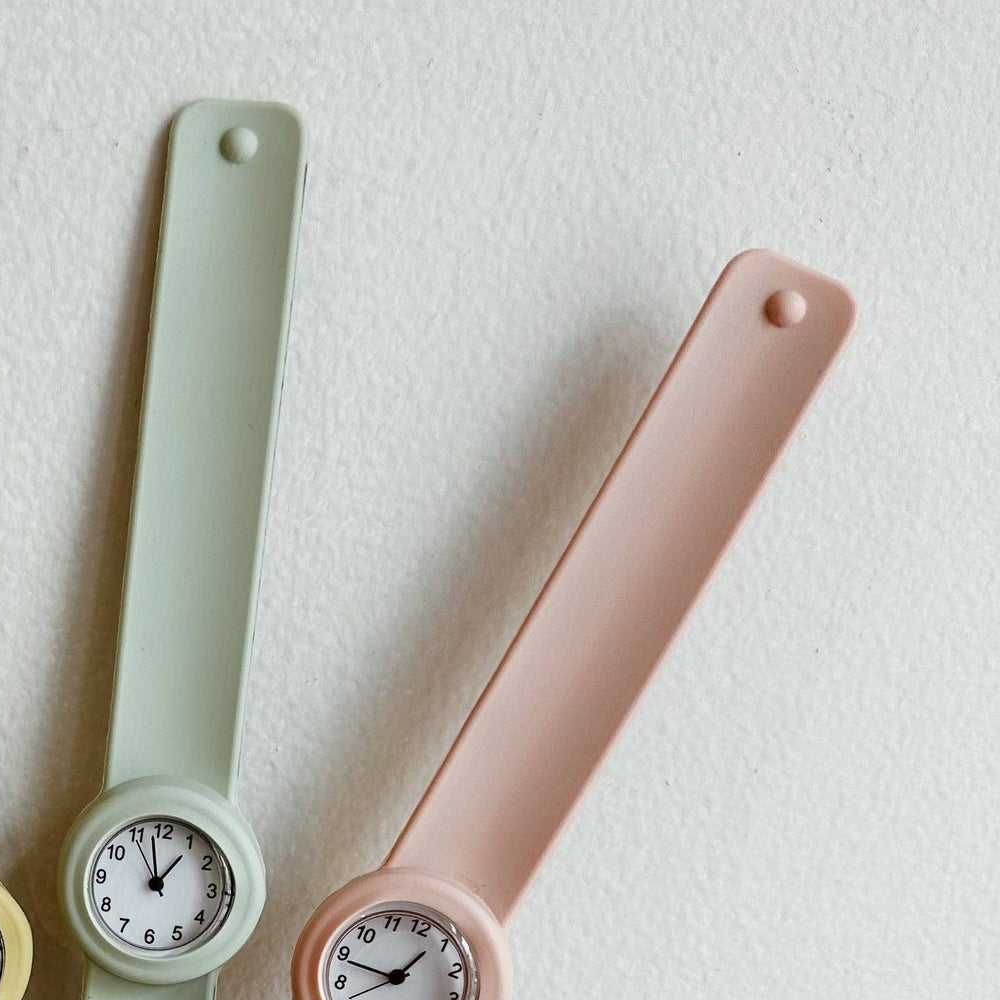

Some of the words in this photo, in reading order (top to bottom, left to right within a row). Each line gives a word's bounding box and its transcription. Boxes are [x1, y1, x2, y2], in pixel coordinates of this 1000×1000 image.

[129, 827, 144, 843] 11
[154, 824, 174, 840] 12
[186, 834, 193, 849] 1
[107, 844, 125, 860] 10
[202, 856, 213, 870] 2
[96, 869, 106, 884] 9
[207, 884, 217, 898] 3
[101, 897, 111, 912] 8
[194, 910, 205, 925] 4
[384, 916, 402, 932] 11
[120, 918, 130, 933] 7
[172, 926, 182, 940] 5
[412, 920, 431, 937] 12
[144, 929, 155, 944] 6
[357, 925, 376, 943] 10
[441, 939, 448, 952] 1
[337, 946, 350, 961] 9
[448, 963, 462, 979] 2
[334, 975, 347, 990] 8
